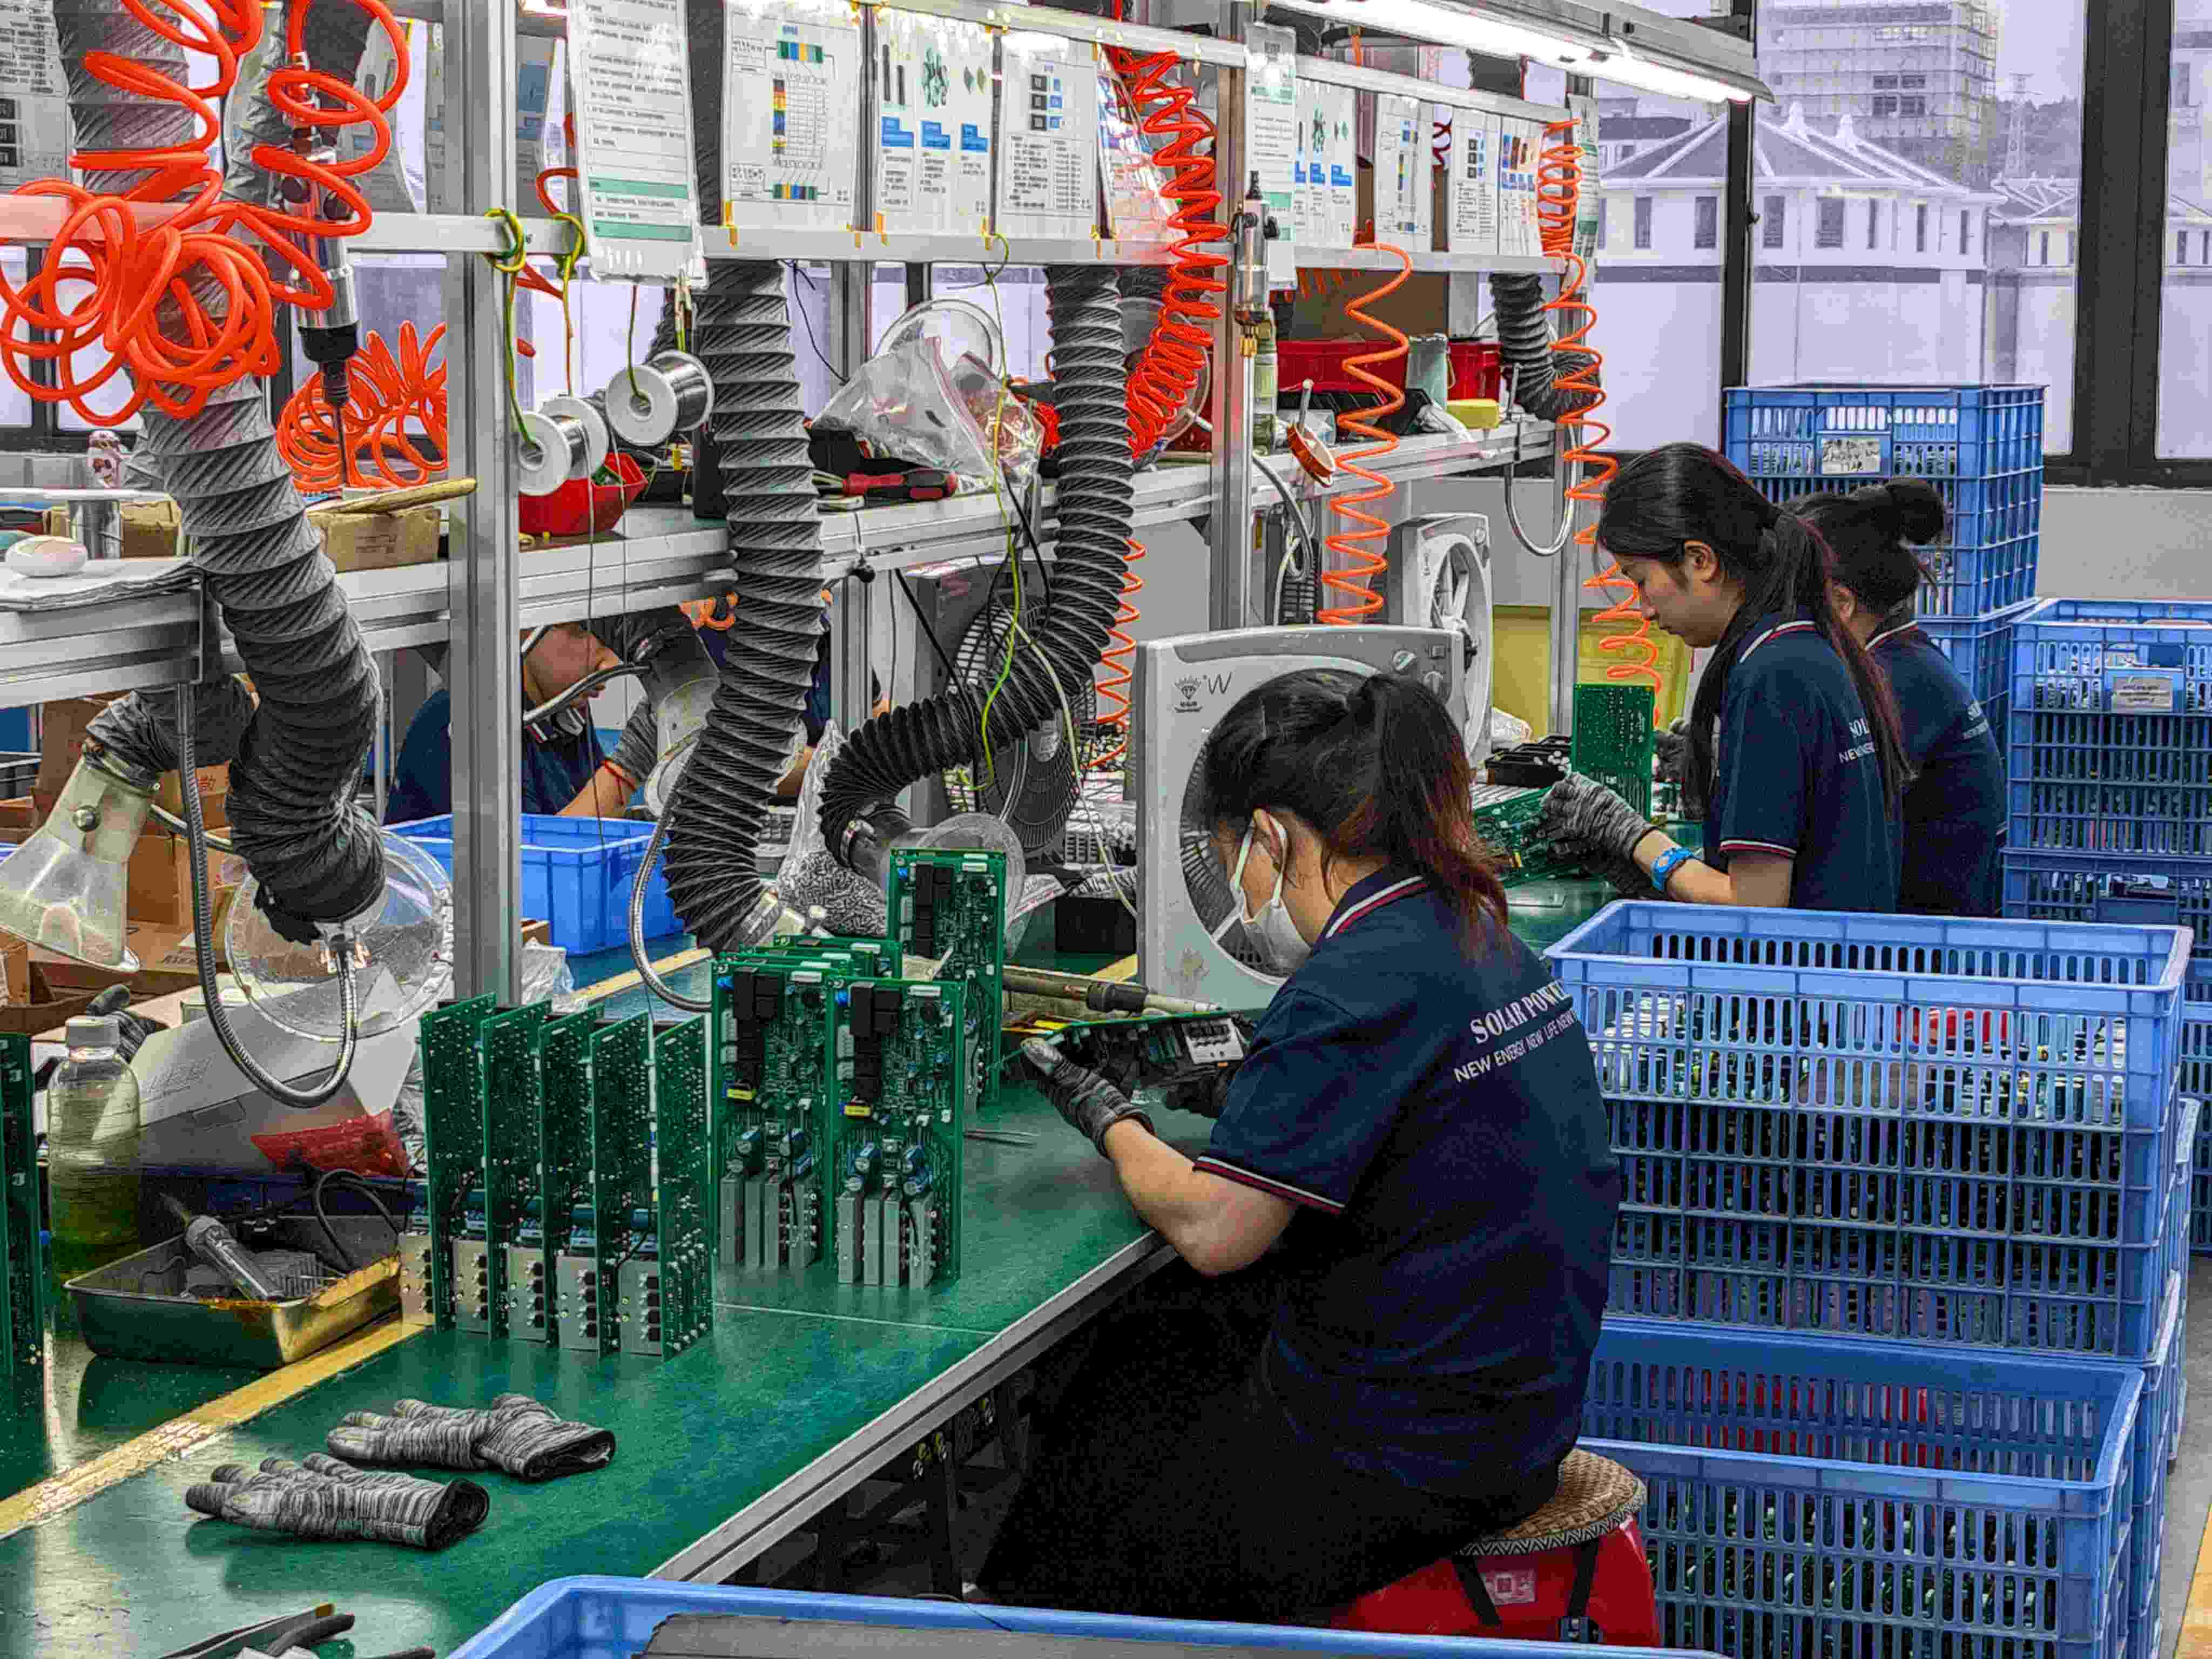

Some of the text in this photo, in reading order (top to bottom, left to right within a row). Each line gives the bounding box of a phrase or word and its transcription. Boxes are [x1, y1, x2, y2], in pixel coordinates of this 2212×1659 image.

[1470, 979, 1573, 1043] SOLAR POWE
[1453, 1055, 1492, 1082] NEW
[1494, 1038, 1526, 1066] ENERGY
[1526, 1030, 1544, 1050] NEW
[1555, 1011, 1574, 1032] NEW
